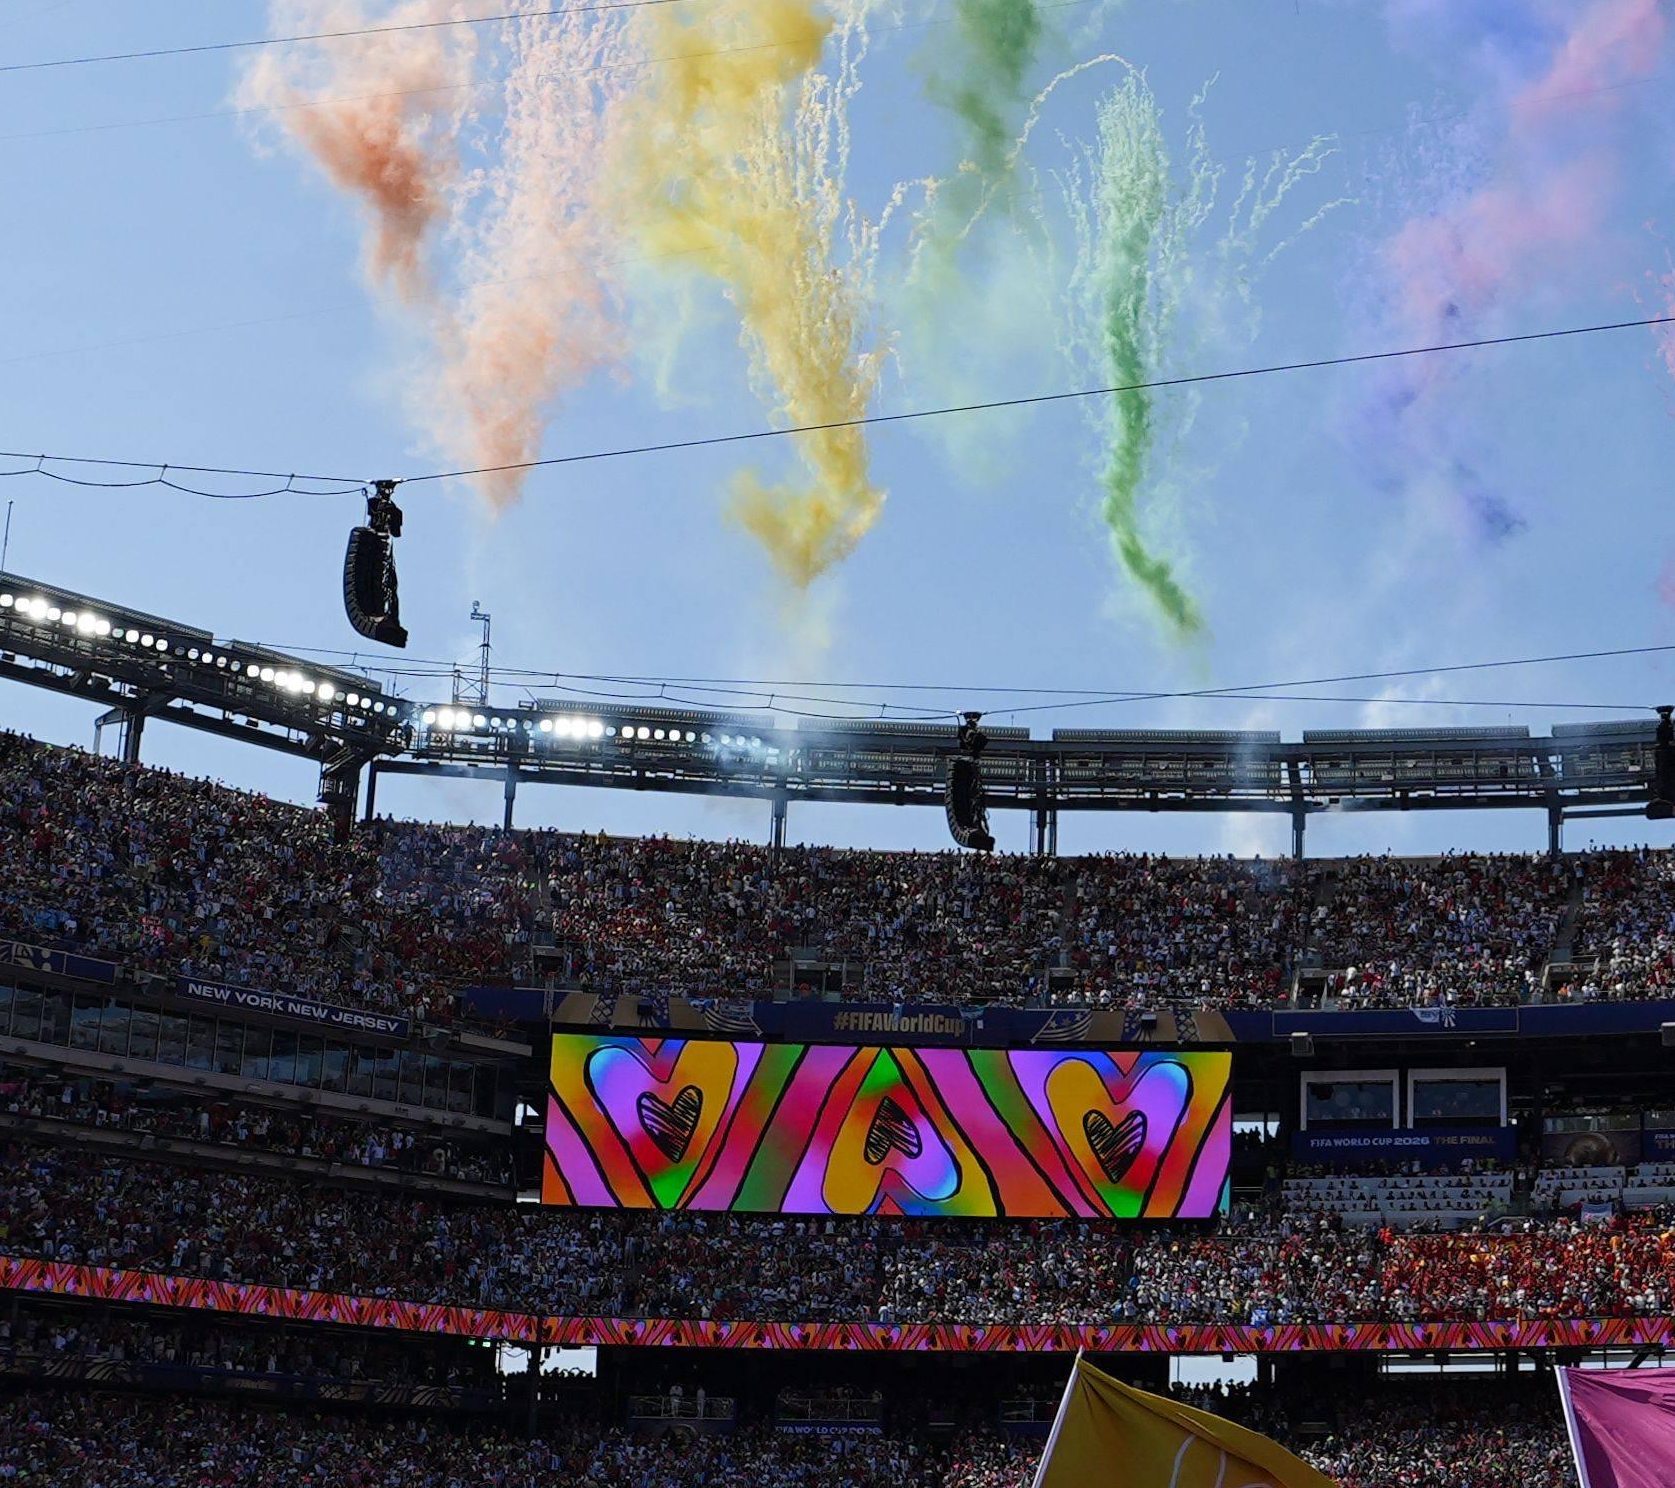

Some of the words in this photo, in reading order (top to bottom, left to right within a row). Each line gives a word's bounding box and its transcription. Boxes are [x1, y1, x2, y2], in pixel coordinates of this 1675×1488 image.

[187, 981, 230, 1001] NEW
[234, 989, 284, 1012] YORK
[286, 999, 328, 1019] NEW
[331, 1007, 398, 1032] JERSEY
[833, 1011, 965, 1037] #FIFAWorldCup
[1310, 1138, 1330, 1149] FIFA
[1331, 1137, 1370, 1148] WORLD
[1371, 1137, 1392, 1148] CUP
[1393, 1135, 1430, 1147] 2026
